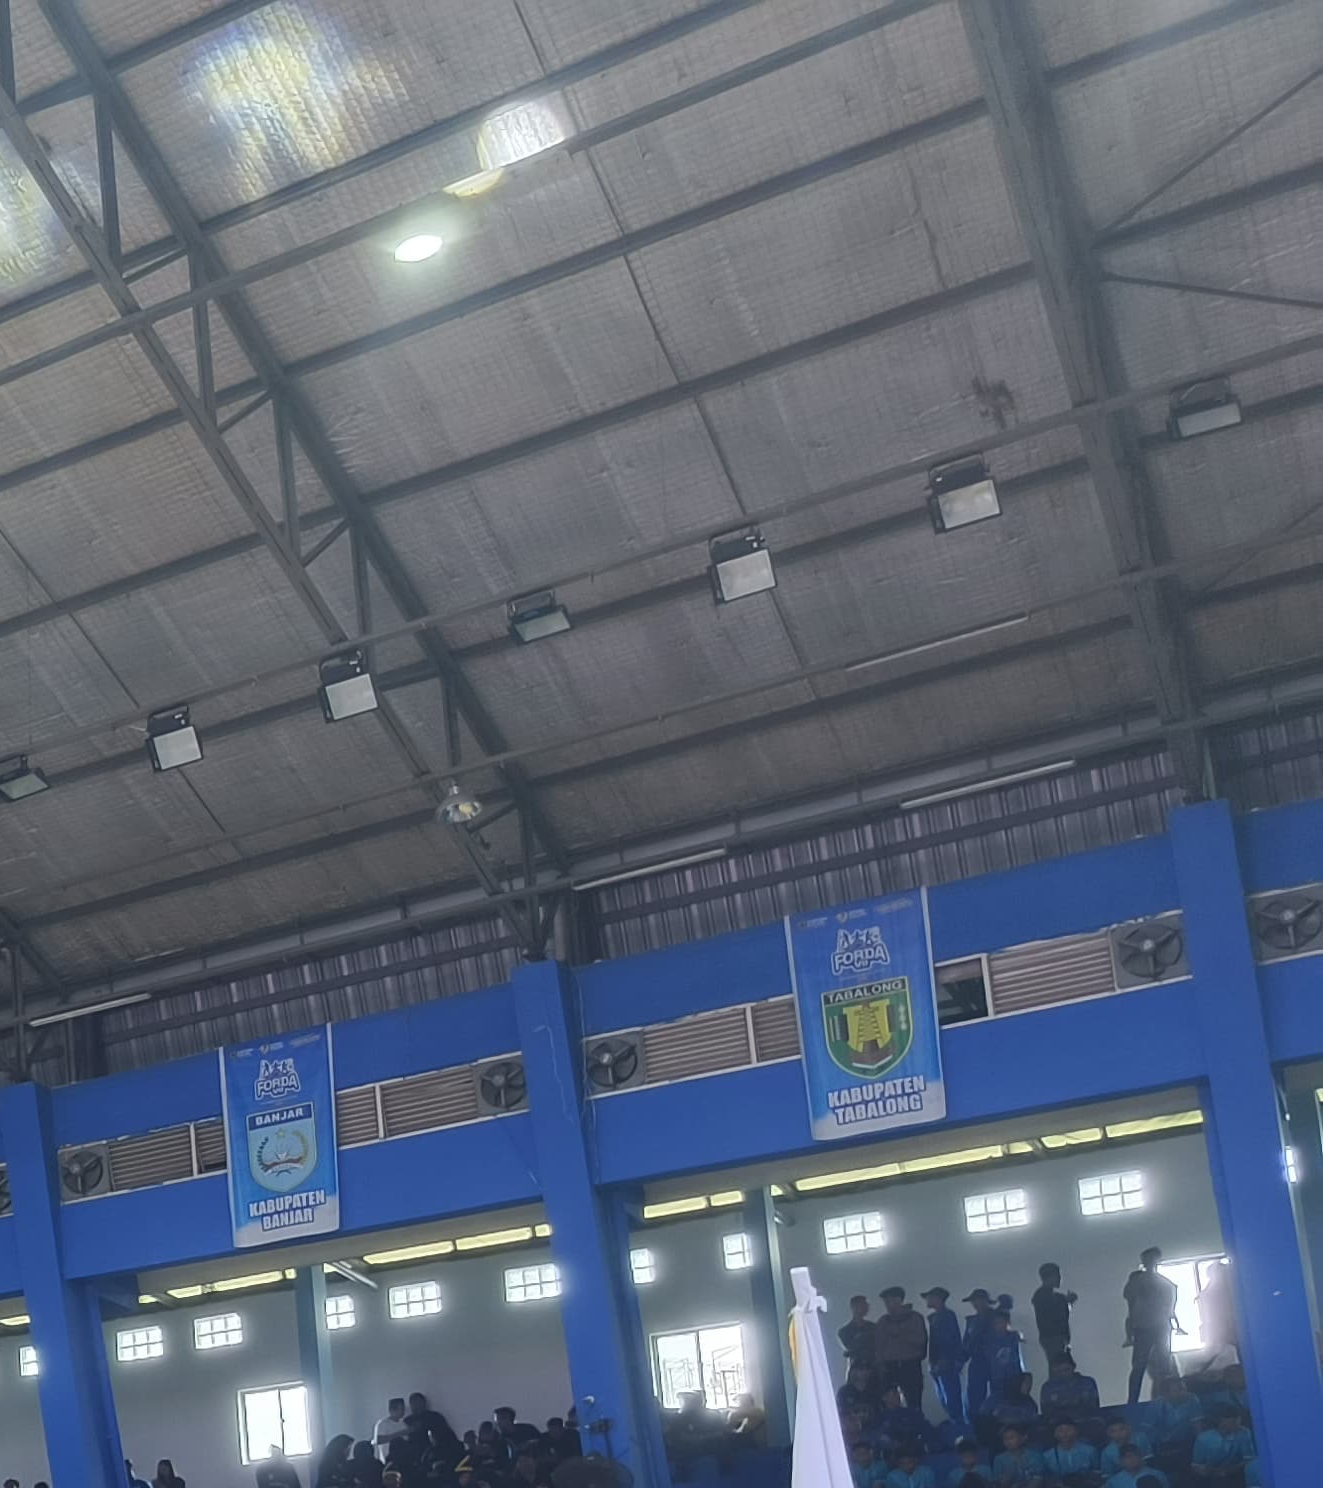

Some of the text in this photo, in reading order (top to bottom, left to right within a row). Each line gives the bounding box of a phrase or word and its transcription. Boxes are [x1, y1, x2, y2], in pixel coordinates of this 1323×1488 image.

[834, 946, 887, 970] FORDA
[828, 979, 904, 1003] TABALONG
[257, 1076, 299, 1096] FORDA
[828, 1076, 926, 1108] KABUPATEN
[255, 1109, 304, 1126] BANJAR
[835, 1094, 922, 1125] TABALONG
[249, 1190, 325, 1217] KABUPATEN
[262, 1209, 314, 1231] BANJAR
